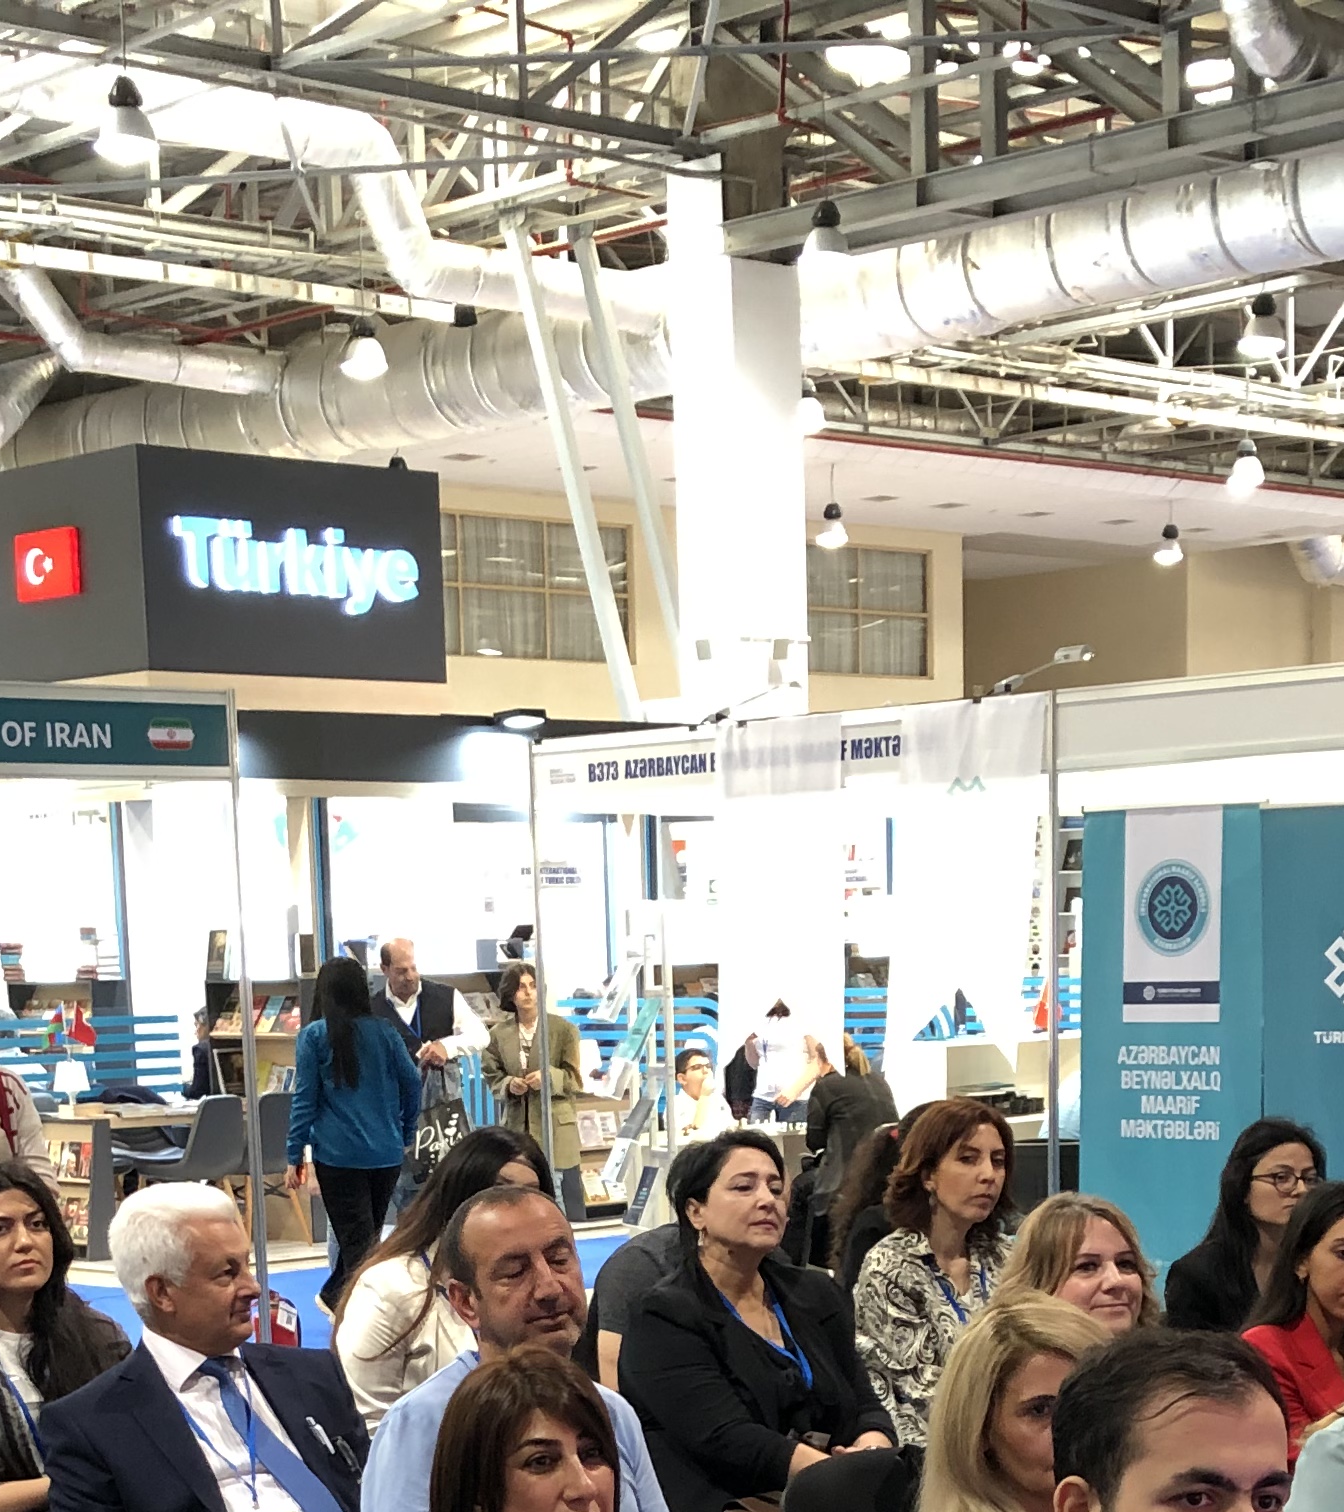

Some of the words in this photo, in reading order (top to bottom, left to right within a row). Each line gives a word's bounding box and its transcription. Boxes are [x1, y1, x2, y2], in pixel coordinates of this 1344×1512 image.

[167, 514, 422, 616] Türkiye
[1, 720, 37, 748] OF
[46, 722, 112, 749] IRAN
[588, 760, 619, 782] B373
[624, 753, 707, 779] AZƏRBAYCAN
[850, 735, 901, 760] MƏKTƏ
[1117, 1045, 1221, 1065] AZƏRBAYCAN
[1120, 1069, 1221, 1091] BEYNƏLXALQ
[1141, 1094, 1201, 1115] MAARİF
[1120, 1120, 1220, 1141] MƏKTƏBLƏRİ
